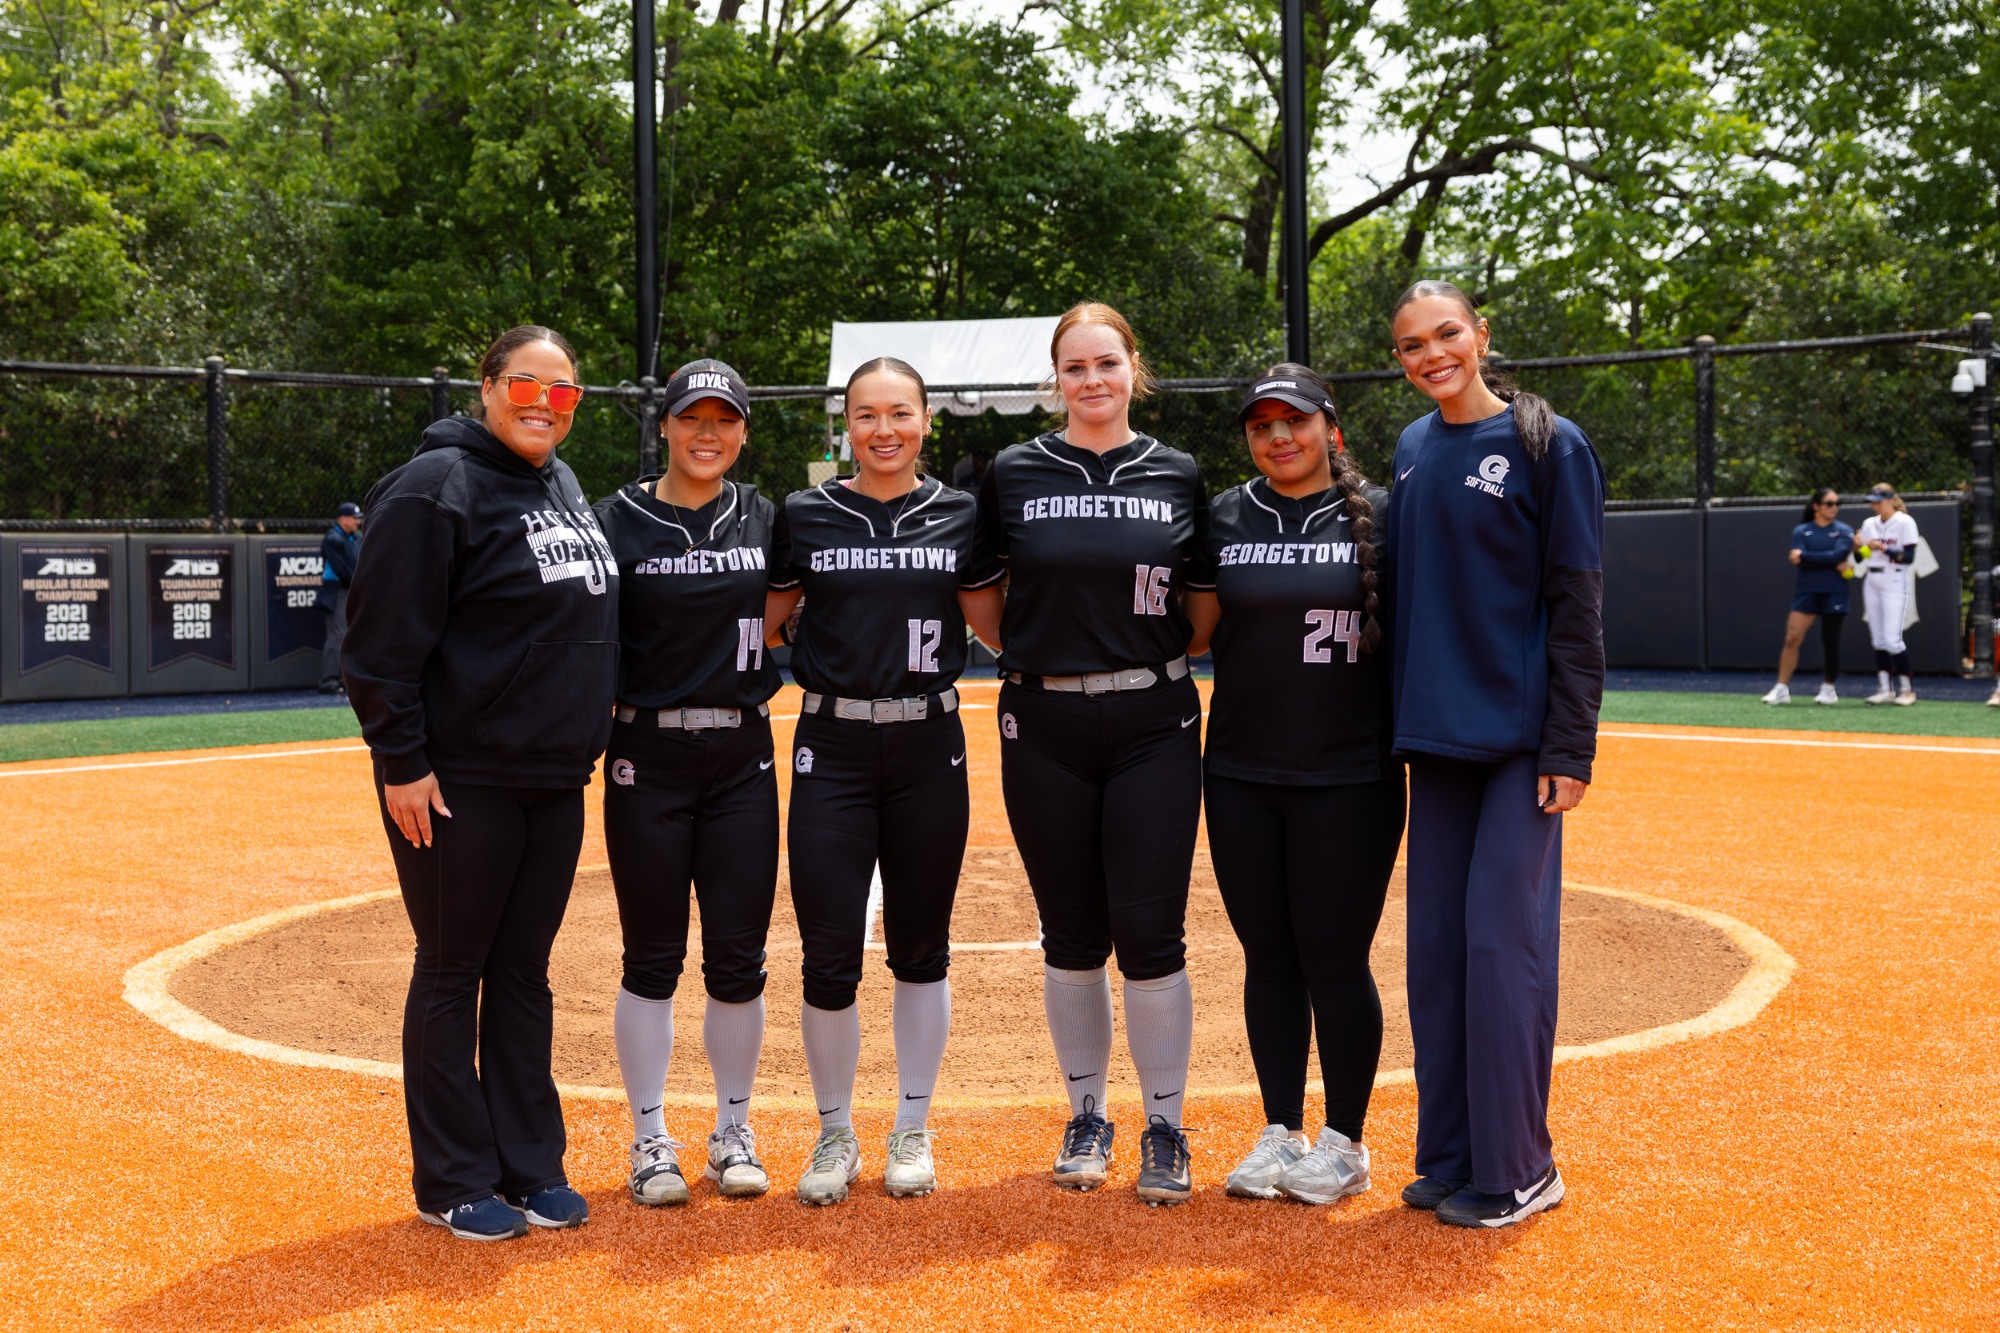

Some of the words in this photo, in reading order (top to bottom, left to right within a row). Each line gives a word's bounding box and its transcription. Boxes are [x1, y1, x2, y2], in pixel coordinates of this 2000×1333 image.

[688, 373, 732, 393] HOYAS
[1464, 475, 1504, 498] SOFTBALL
[1023, 495, 1172, 523] GEORGETOWN
[811, 547, 956, 572] GEORGETOWN
[23, 579, 68, 590] REGULAR
[70, 578, 109, 589] SEASON
[160, 579, 223, 590] TOURNAMENT
[275, 576, 323, 587] TOURNAME
[1134, 564, 1171, 616] 16
[35, 590, 98, 602] CHAMPIONS
[163, 590, 221, 601] CHAMPIONS
[47, 604, 88, 622] 2021
[173, 603, 211, 621] 2019
[45, 623, 90, 641] 2022
[173, 621, 211, 639] 2021
[1303, 610, 1361, 663] 24
[737, 618, 763, 671] 14
[908, 619, 942, 672] 12
